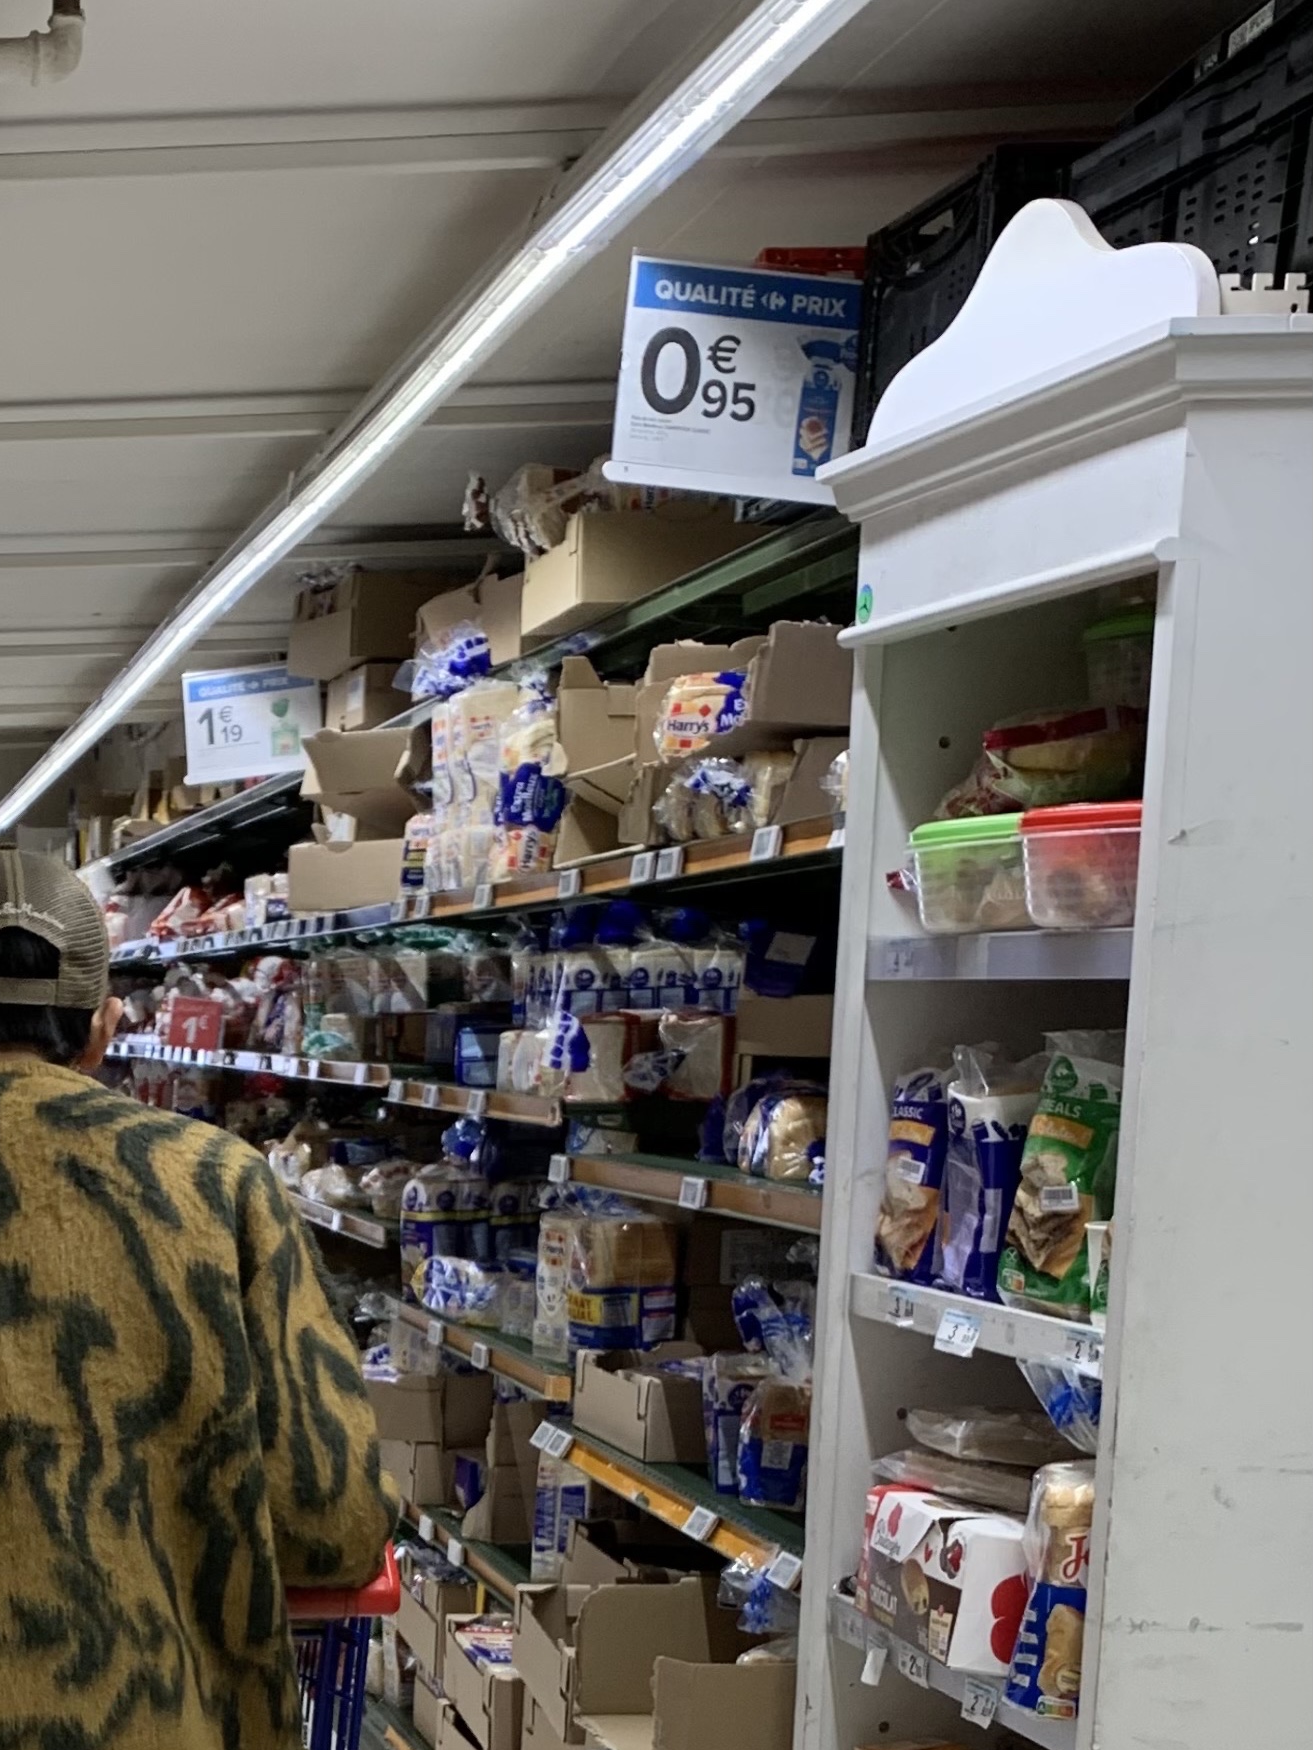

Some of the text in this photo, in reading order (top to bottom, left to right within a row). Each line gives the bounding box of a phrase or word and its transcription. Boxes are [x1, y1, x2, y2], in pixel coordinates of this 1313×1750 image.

[654, 280, 846, 318] QUALITÉ PRIX
[640, 327, 756, 422] 0 € 95
[196, 708, 215, 745] 1
[220, 724, 243, 744] 19
[666, 719, 710, 735] Harrys
